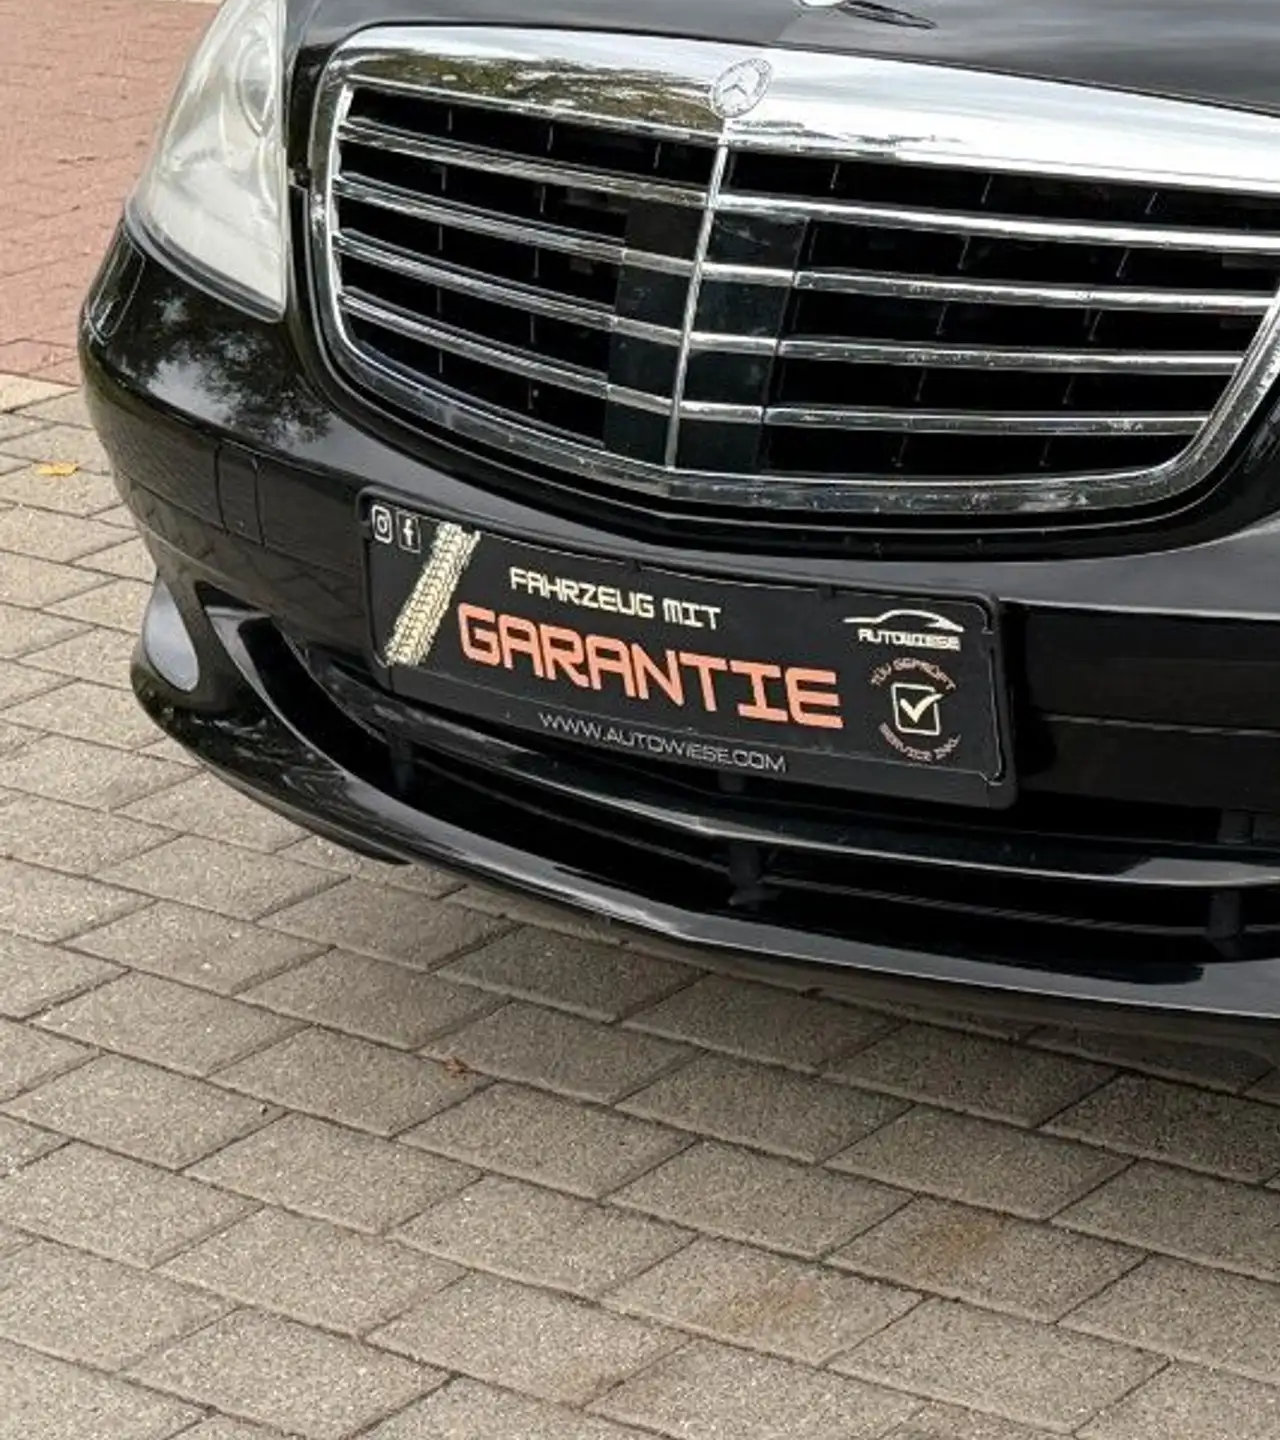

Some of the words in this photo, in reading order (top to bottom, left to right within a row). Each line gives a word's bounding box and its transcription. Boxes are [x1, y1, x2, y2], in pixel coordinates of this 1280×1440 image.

[509, 566, 655, 618] FAHRZEUG
[663, 597, 722, 630] MIT
[456, 602, 844, 729] GARANTIE
[857, 627, 961, 652] AUTOWIESE
[537, 712, 787, 773] WWW.AUTOWIESE.COM
